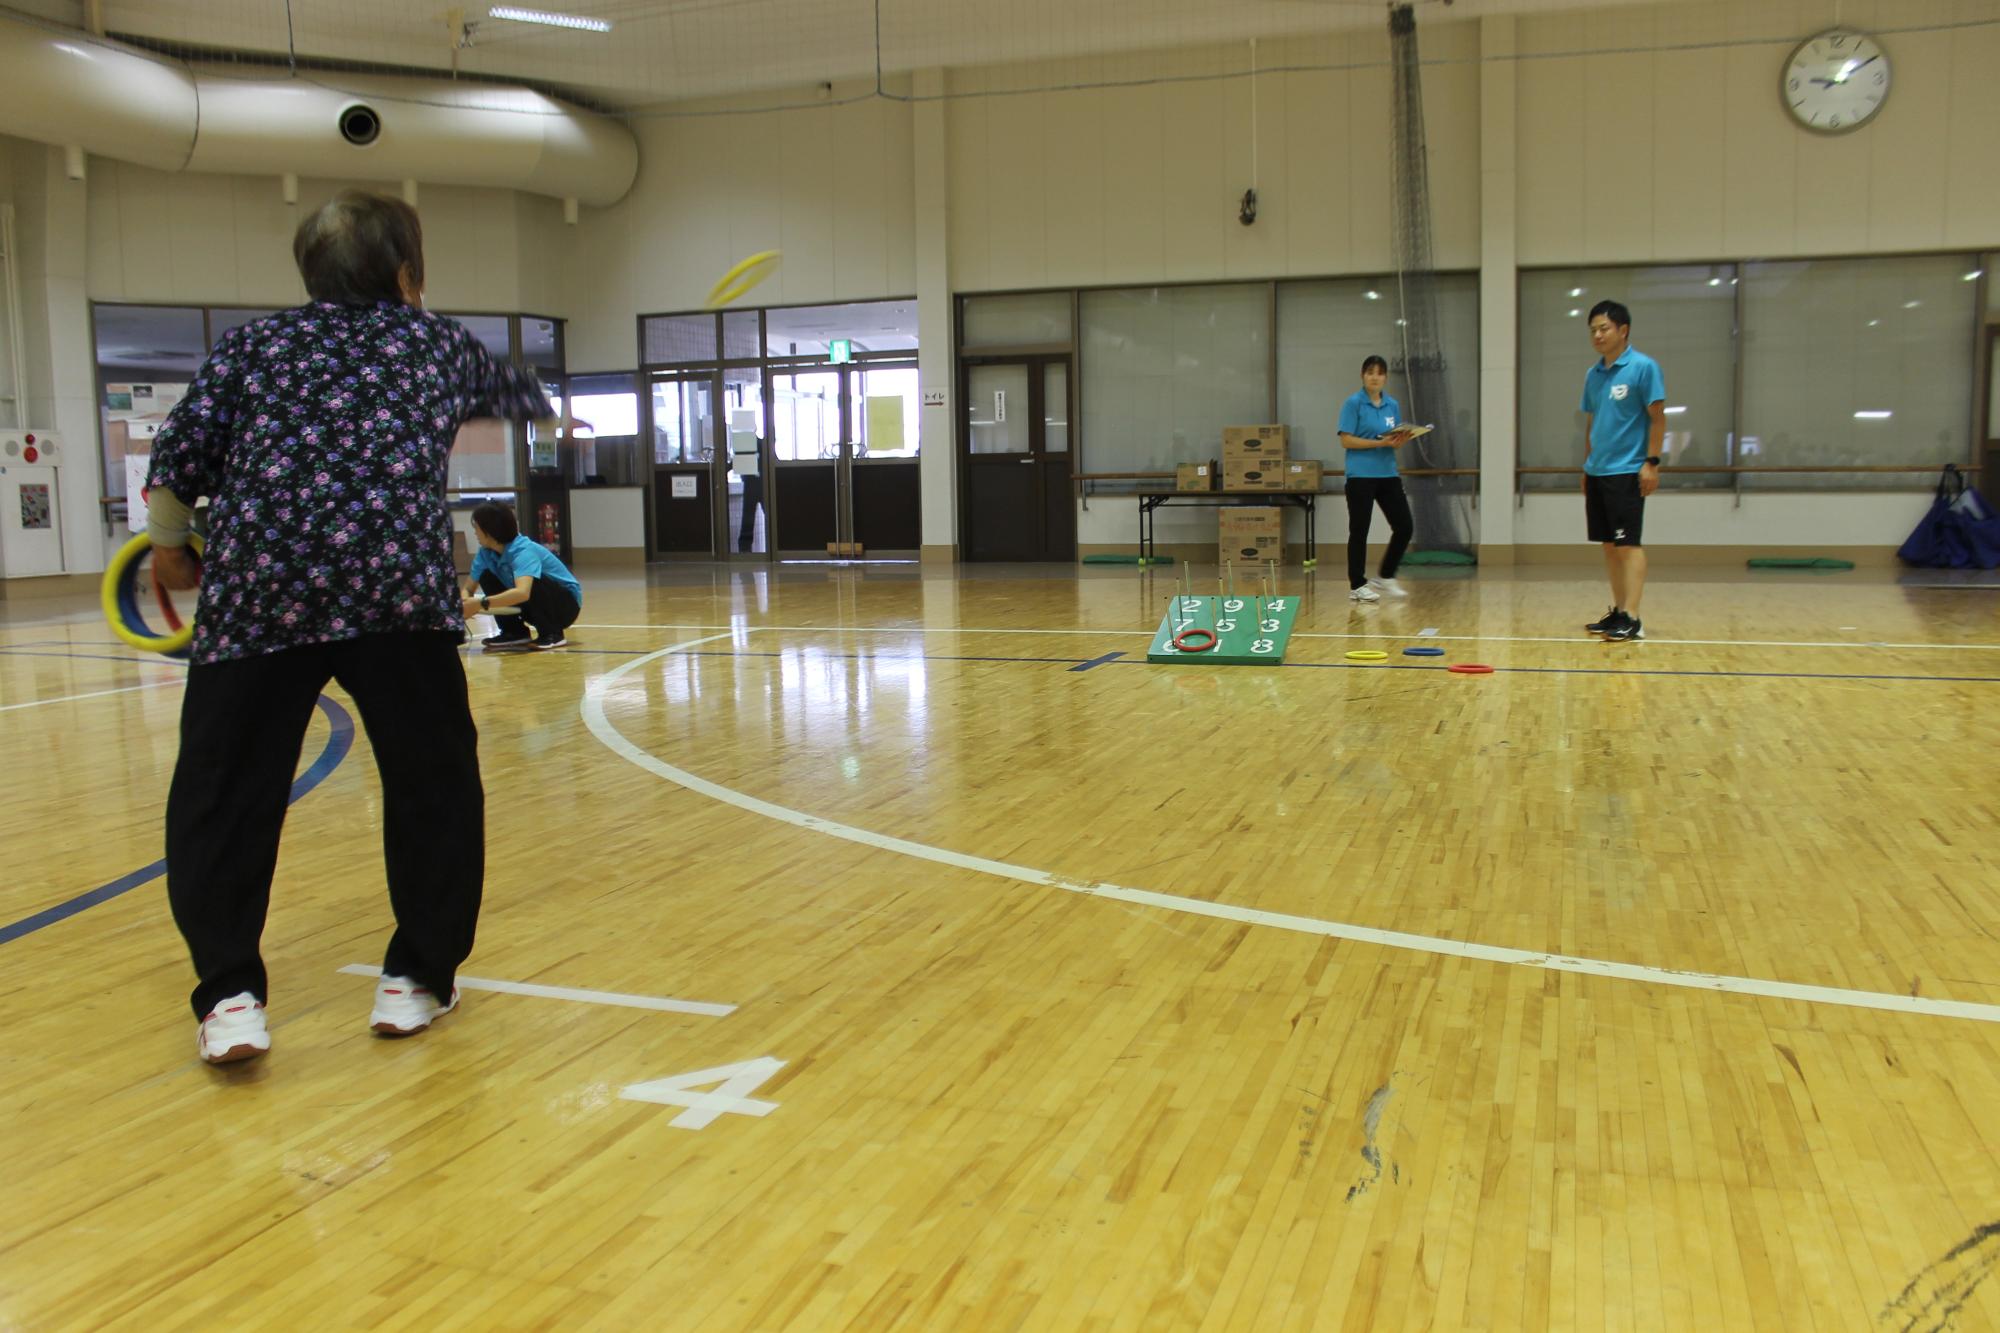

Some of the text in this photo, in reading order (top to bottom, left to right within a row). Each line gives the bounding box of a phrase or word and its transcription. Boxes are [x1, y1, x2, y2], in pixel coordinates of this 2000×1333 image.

[1830, 35, 1846, 49] 12
[1789, 78, 1800, 91] 9
[1873, 72, 1884, 86] 3
[1830, 114, 1841, 129] 6
[924, 392, 945, 401] トイレ
[1181, 599, 1287, 612] 2 9 4
[1175, 619, 1281, 632] 7 5 3
[1163, 639, 1274, 653] 6 1 8
[618, 1055, 791, 1131] 4
